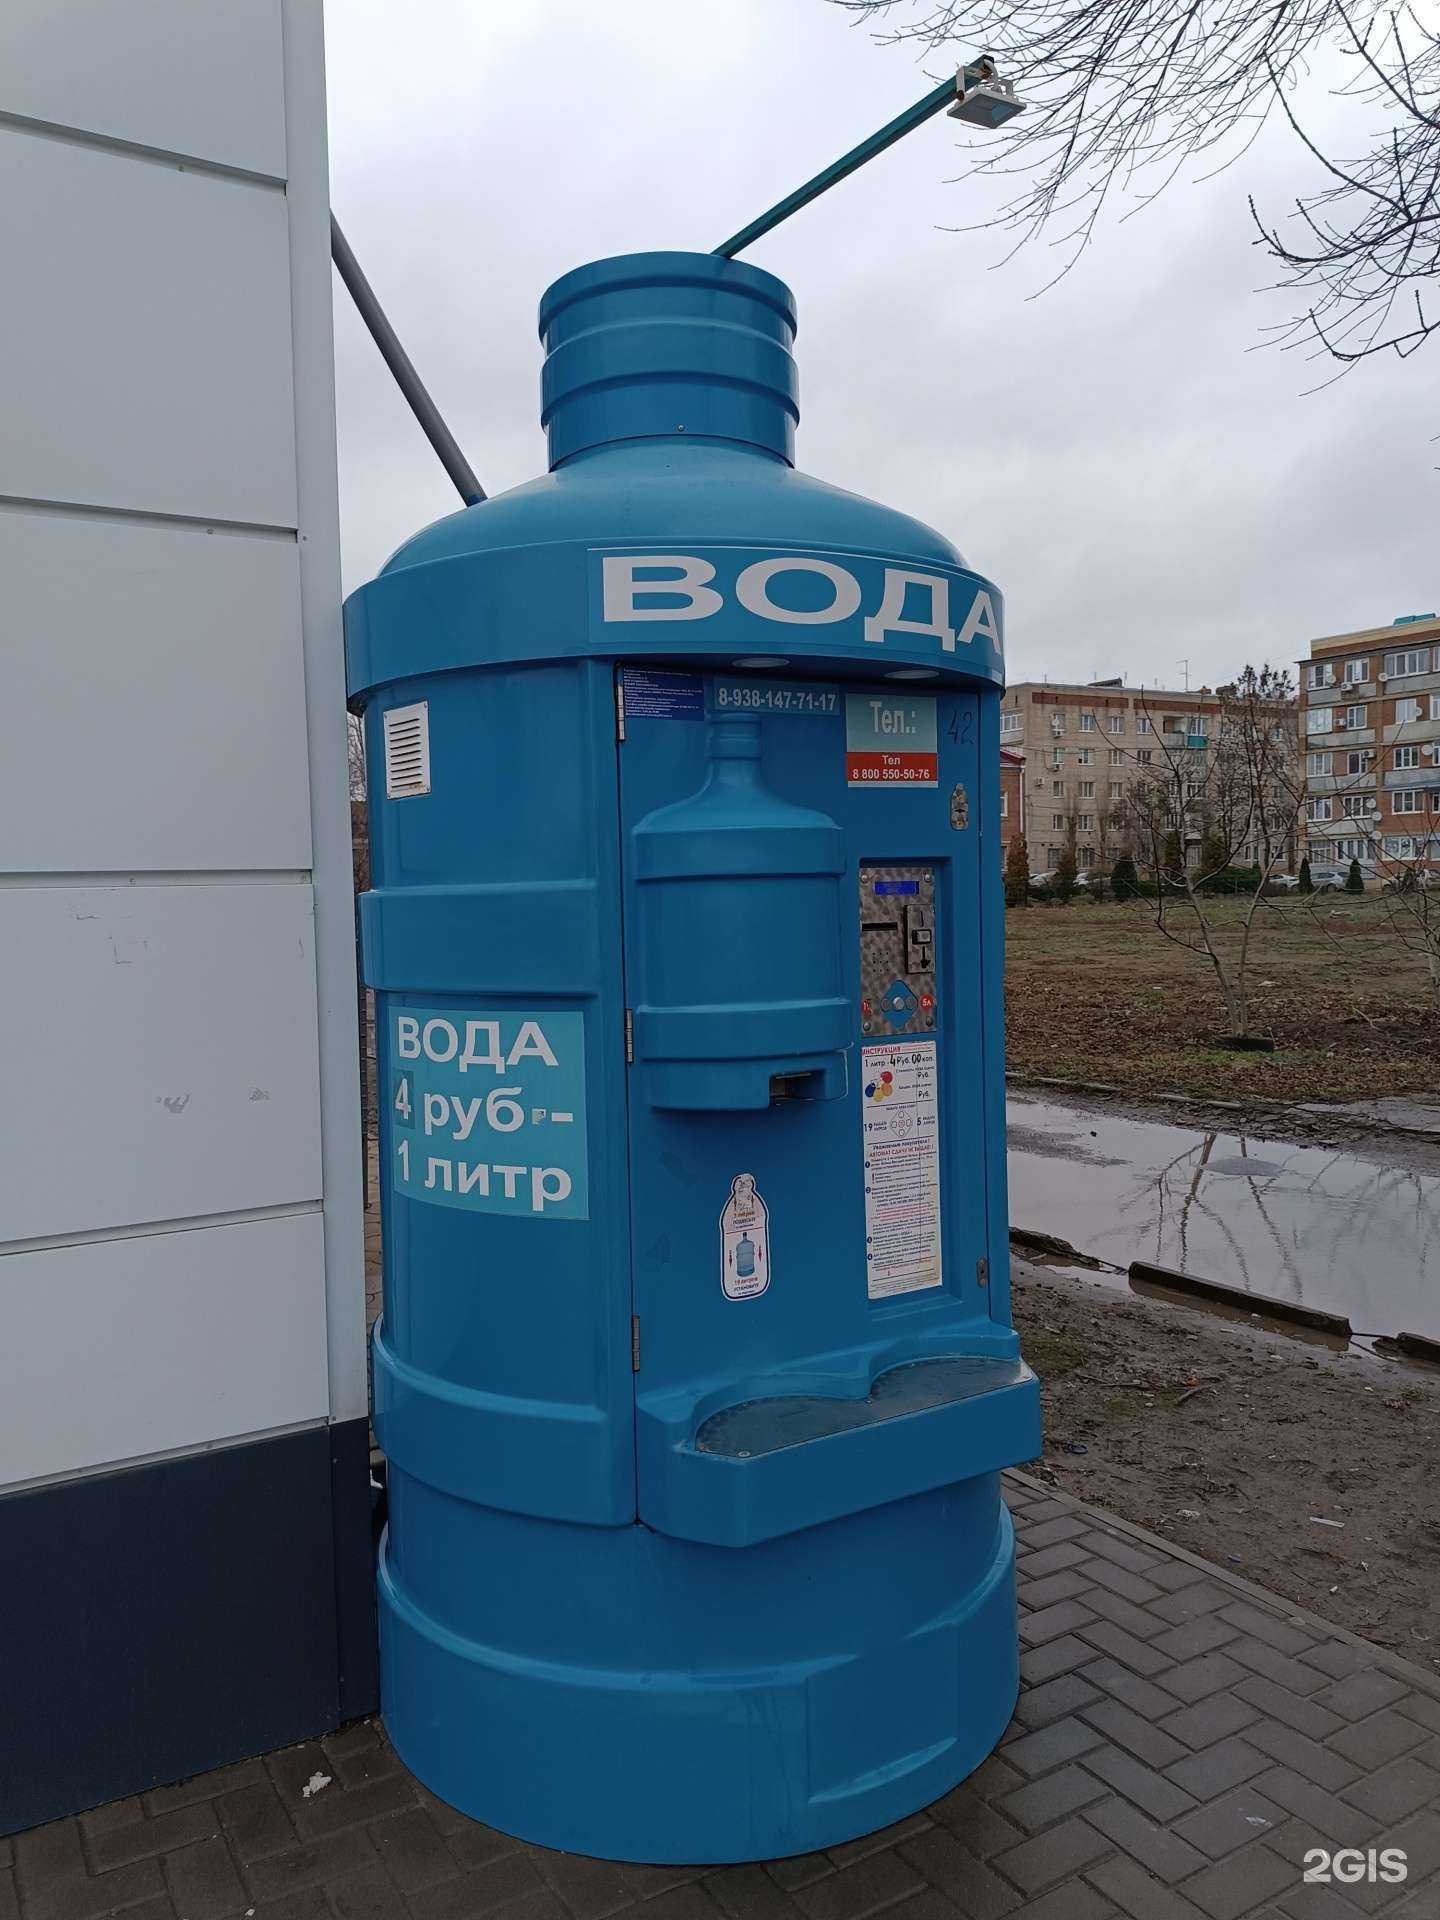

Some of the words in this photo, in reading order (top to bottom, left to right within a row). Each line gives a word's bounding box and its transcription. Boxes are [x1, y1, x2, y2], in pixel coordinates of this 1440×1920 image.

[602, 556, 1001, 655] ВОДА
[718, 687, 837, 711] 8-938-147-71-17
[869, 700, 916, 734] Тел.:
[852, 768, 859, 779] 8
[862, 768, 880, 779] 800
[882, 768, 930, 779] 550-50-76
[881, 754, 901, 766] Тел
[398, 1016, 560, 1074] ВОДА
[395, 1077, 412, 1120] 4
[398, 1139, 409, 1181] 1
[424, 1157, 572, 1212] литр
